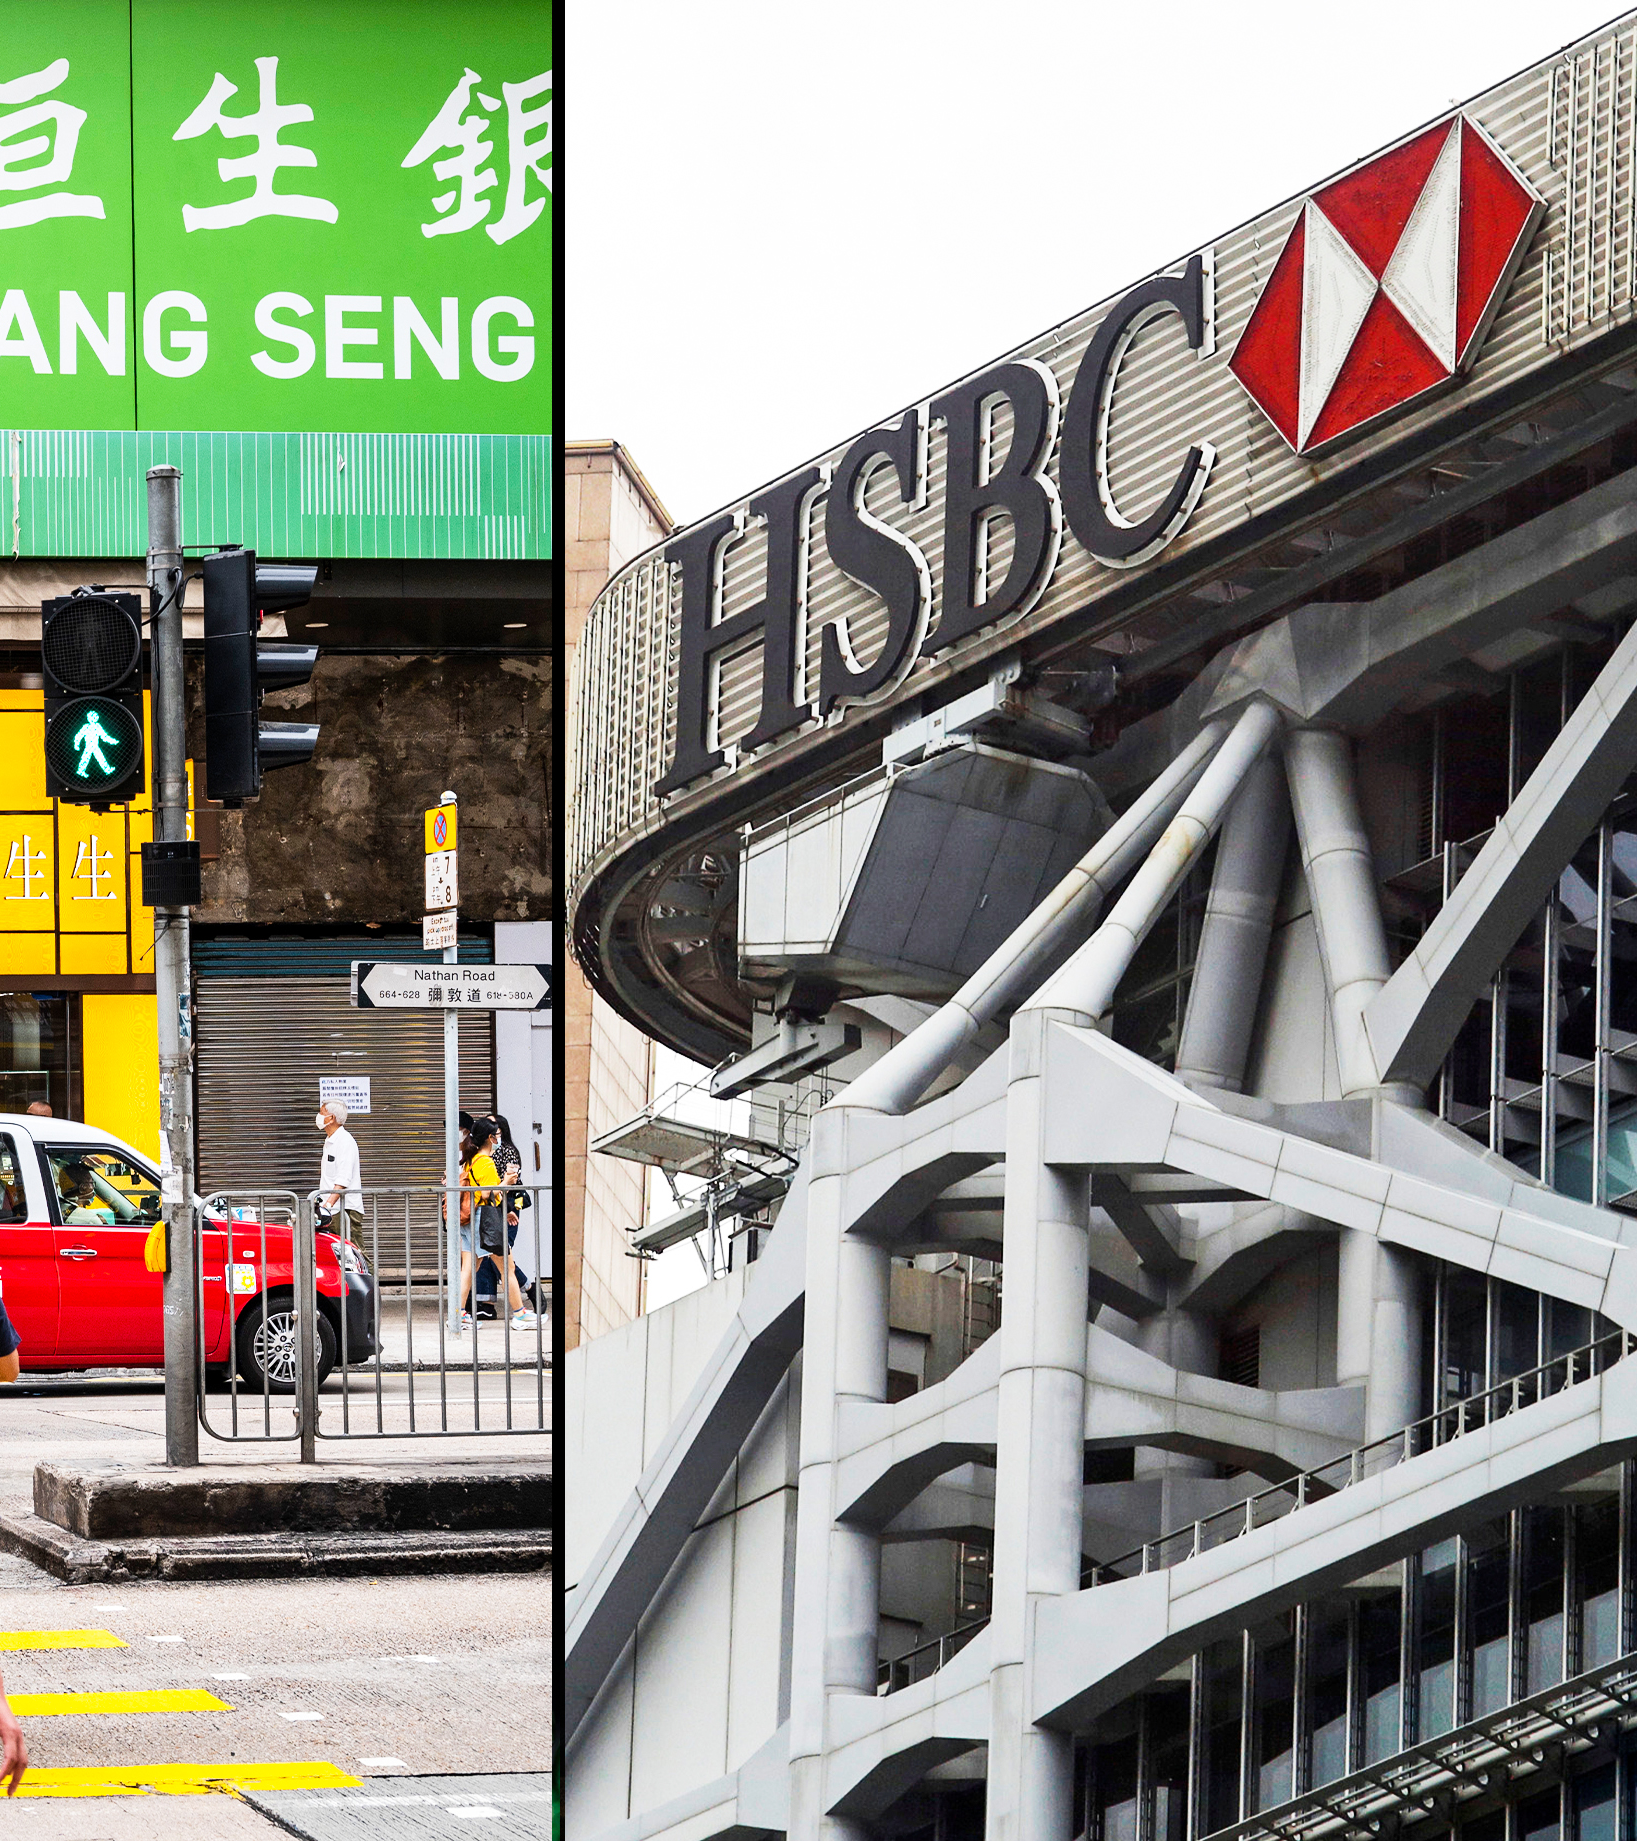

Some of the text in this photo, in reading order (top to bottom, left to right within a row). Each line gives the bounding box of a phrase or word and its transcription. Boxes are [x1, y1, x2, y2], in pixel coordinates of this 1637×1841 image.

[250, 291, 536, 383] SENG
[655, 249, 1216, 799] HSBC
[445, 856, 450, 875] 7
[445, 885, 452, 903] 8
[414, 970, 495, 981] Nathan Road
[379, 990, 421, 999] 664-628
[428, 988, 482, 1002] 彌敦道
